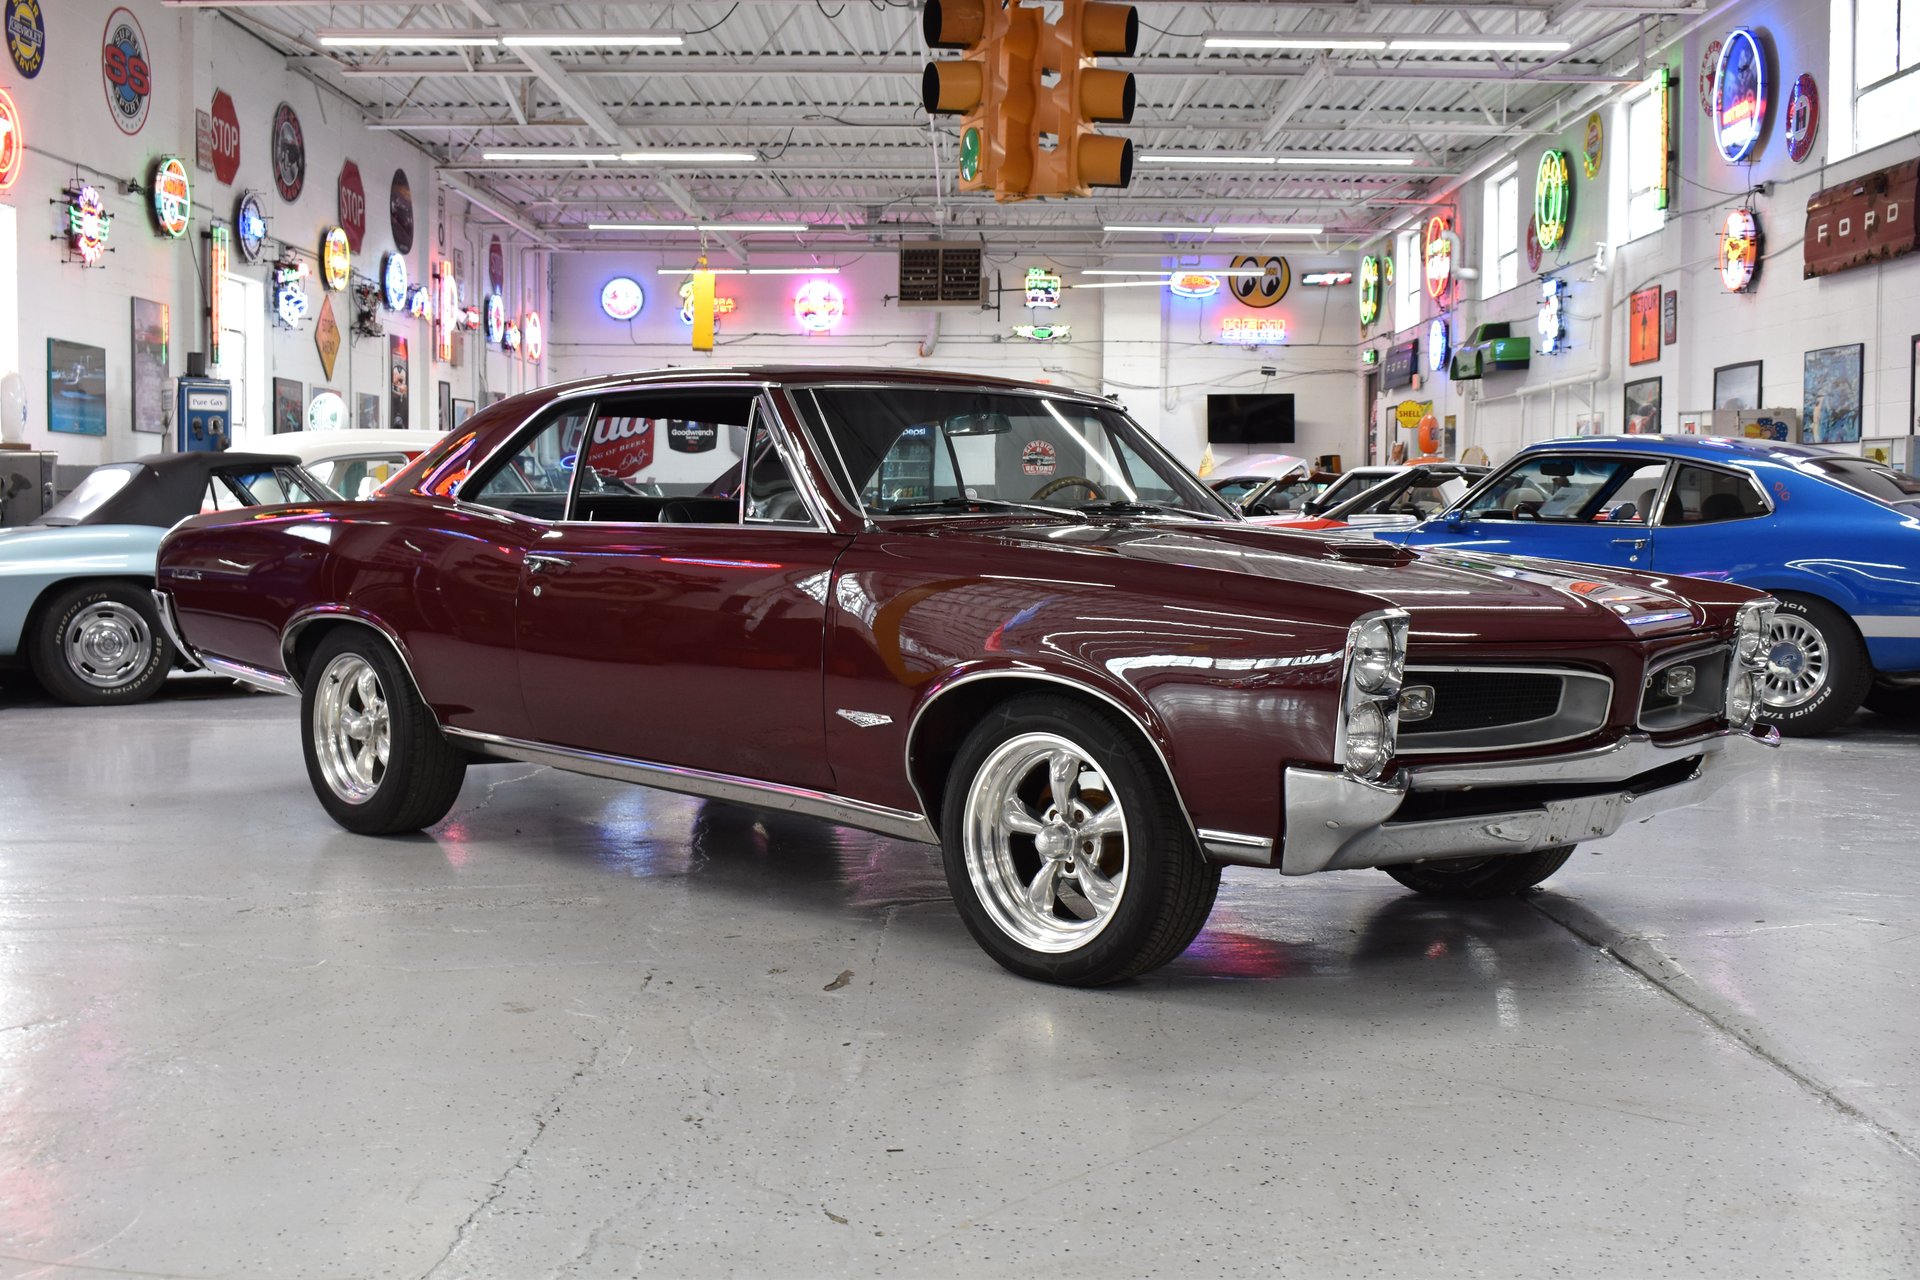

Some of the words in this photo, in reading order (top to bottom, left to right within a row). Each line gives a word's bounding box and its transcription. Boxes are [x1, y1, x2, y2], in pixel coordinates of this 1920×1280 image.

[12, 40, 41, 72] SERVICE
[105, 44, 149, 96] SS
[211, 116, 239, 158] STOP
[342, 187, 364, 225] STOP
[1818, 203, 1899, 243] FORD
[1028, 279, 1058, 289] drive-in
[1632, 292, 1658, 315] DETOUR
[1223, 318, 1285, 331] HEMI
[192, 398, 208, 406] Pure
[210, 398, 223, 406] Gas
[1399, 410, 1421, 418] SHELL
[902, 428, 926, 437] pepsi
[589, 451, 604, 462] ING
[620, 439, 646, 451] BEERS
[56, 602, 82, 645] Radial
[86, 593, 107, 602] T/A
[102, 637, 162, 694] BFGoodrich
[1790, 686, 1832, 719] Radial
